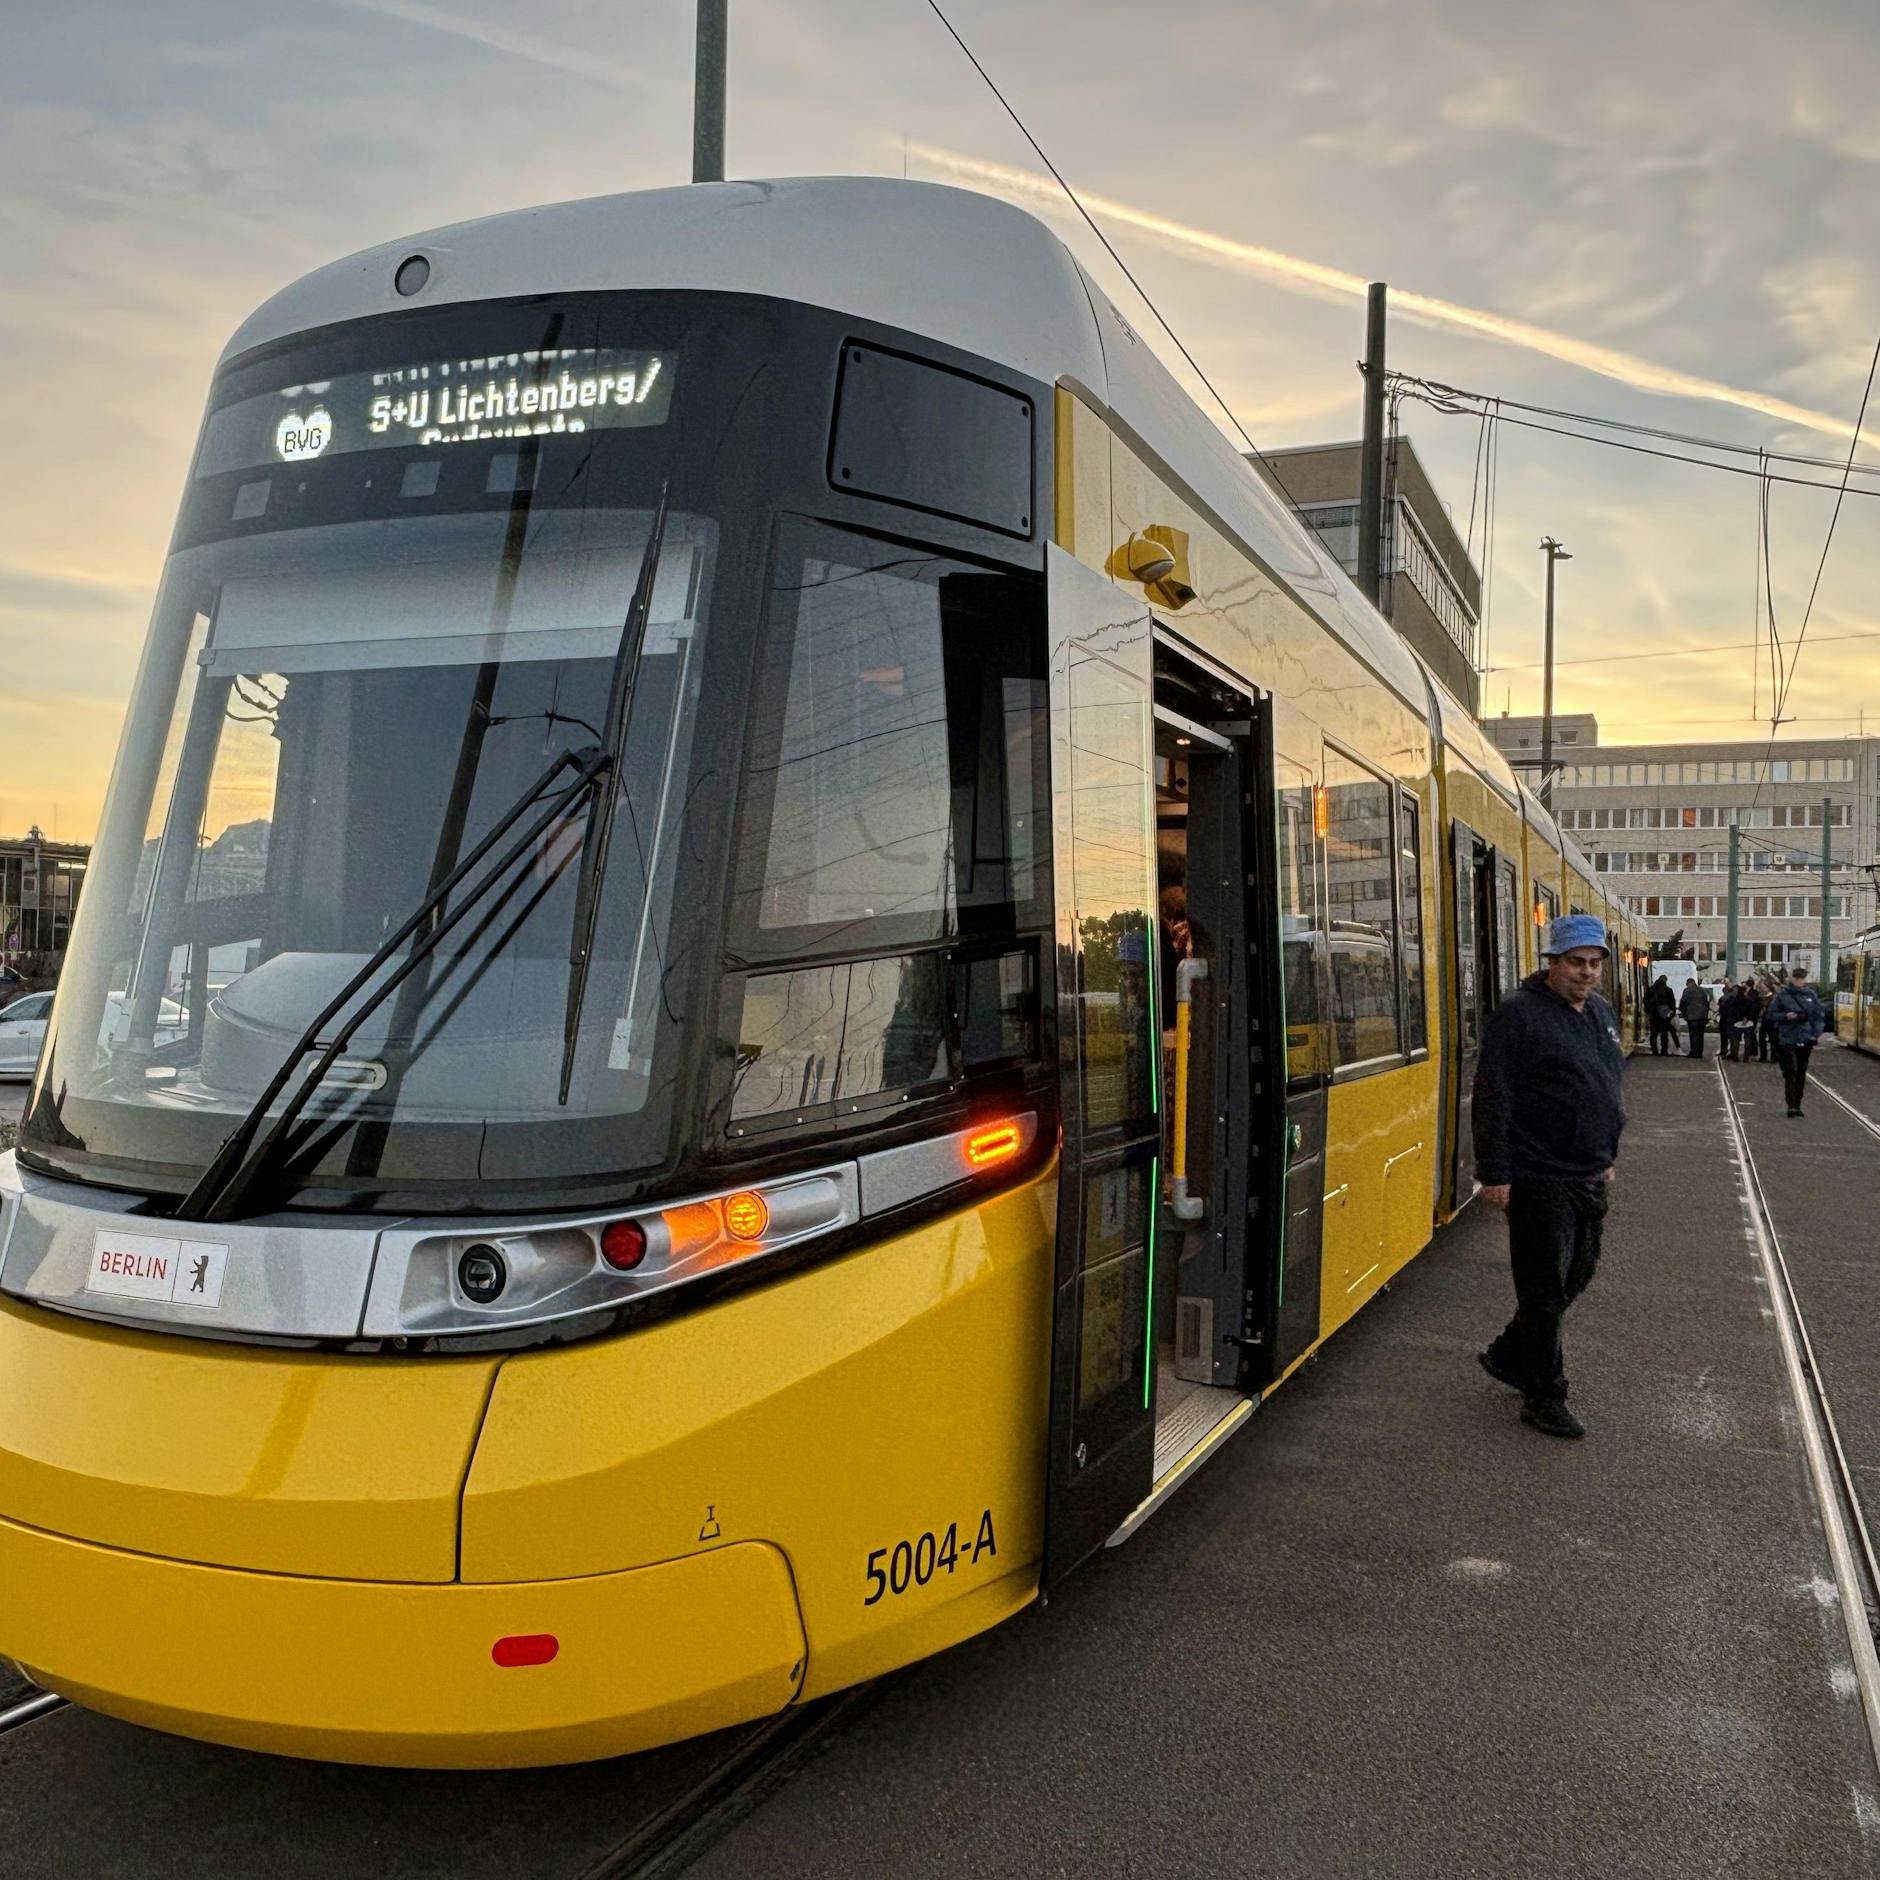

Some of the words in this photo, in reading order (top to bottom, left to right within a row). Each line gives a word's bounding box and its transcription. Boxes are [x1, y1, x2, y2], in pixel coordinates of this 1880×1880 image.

[368, 389, 430, 433] S+U
[438, 356, 663, 425] Lichtenberg/
[284, 427, 322, 453] BVG
[99, 1251, 168, 1280] BERLIN
[863, 1508, 997, 1607] 5004-A
